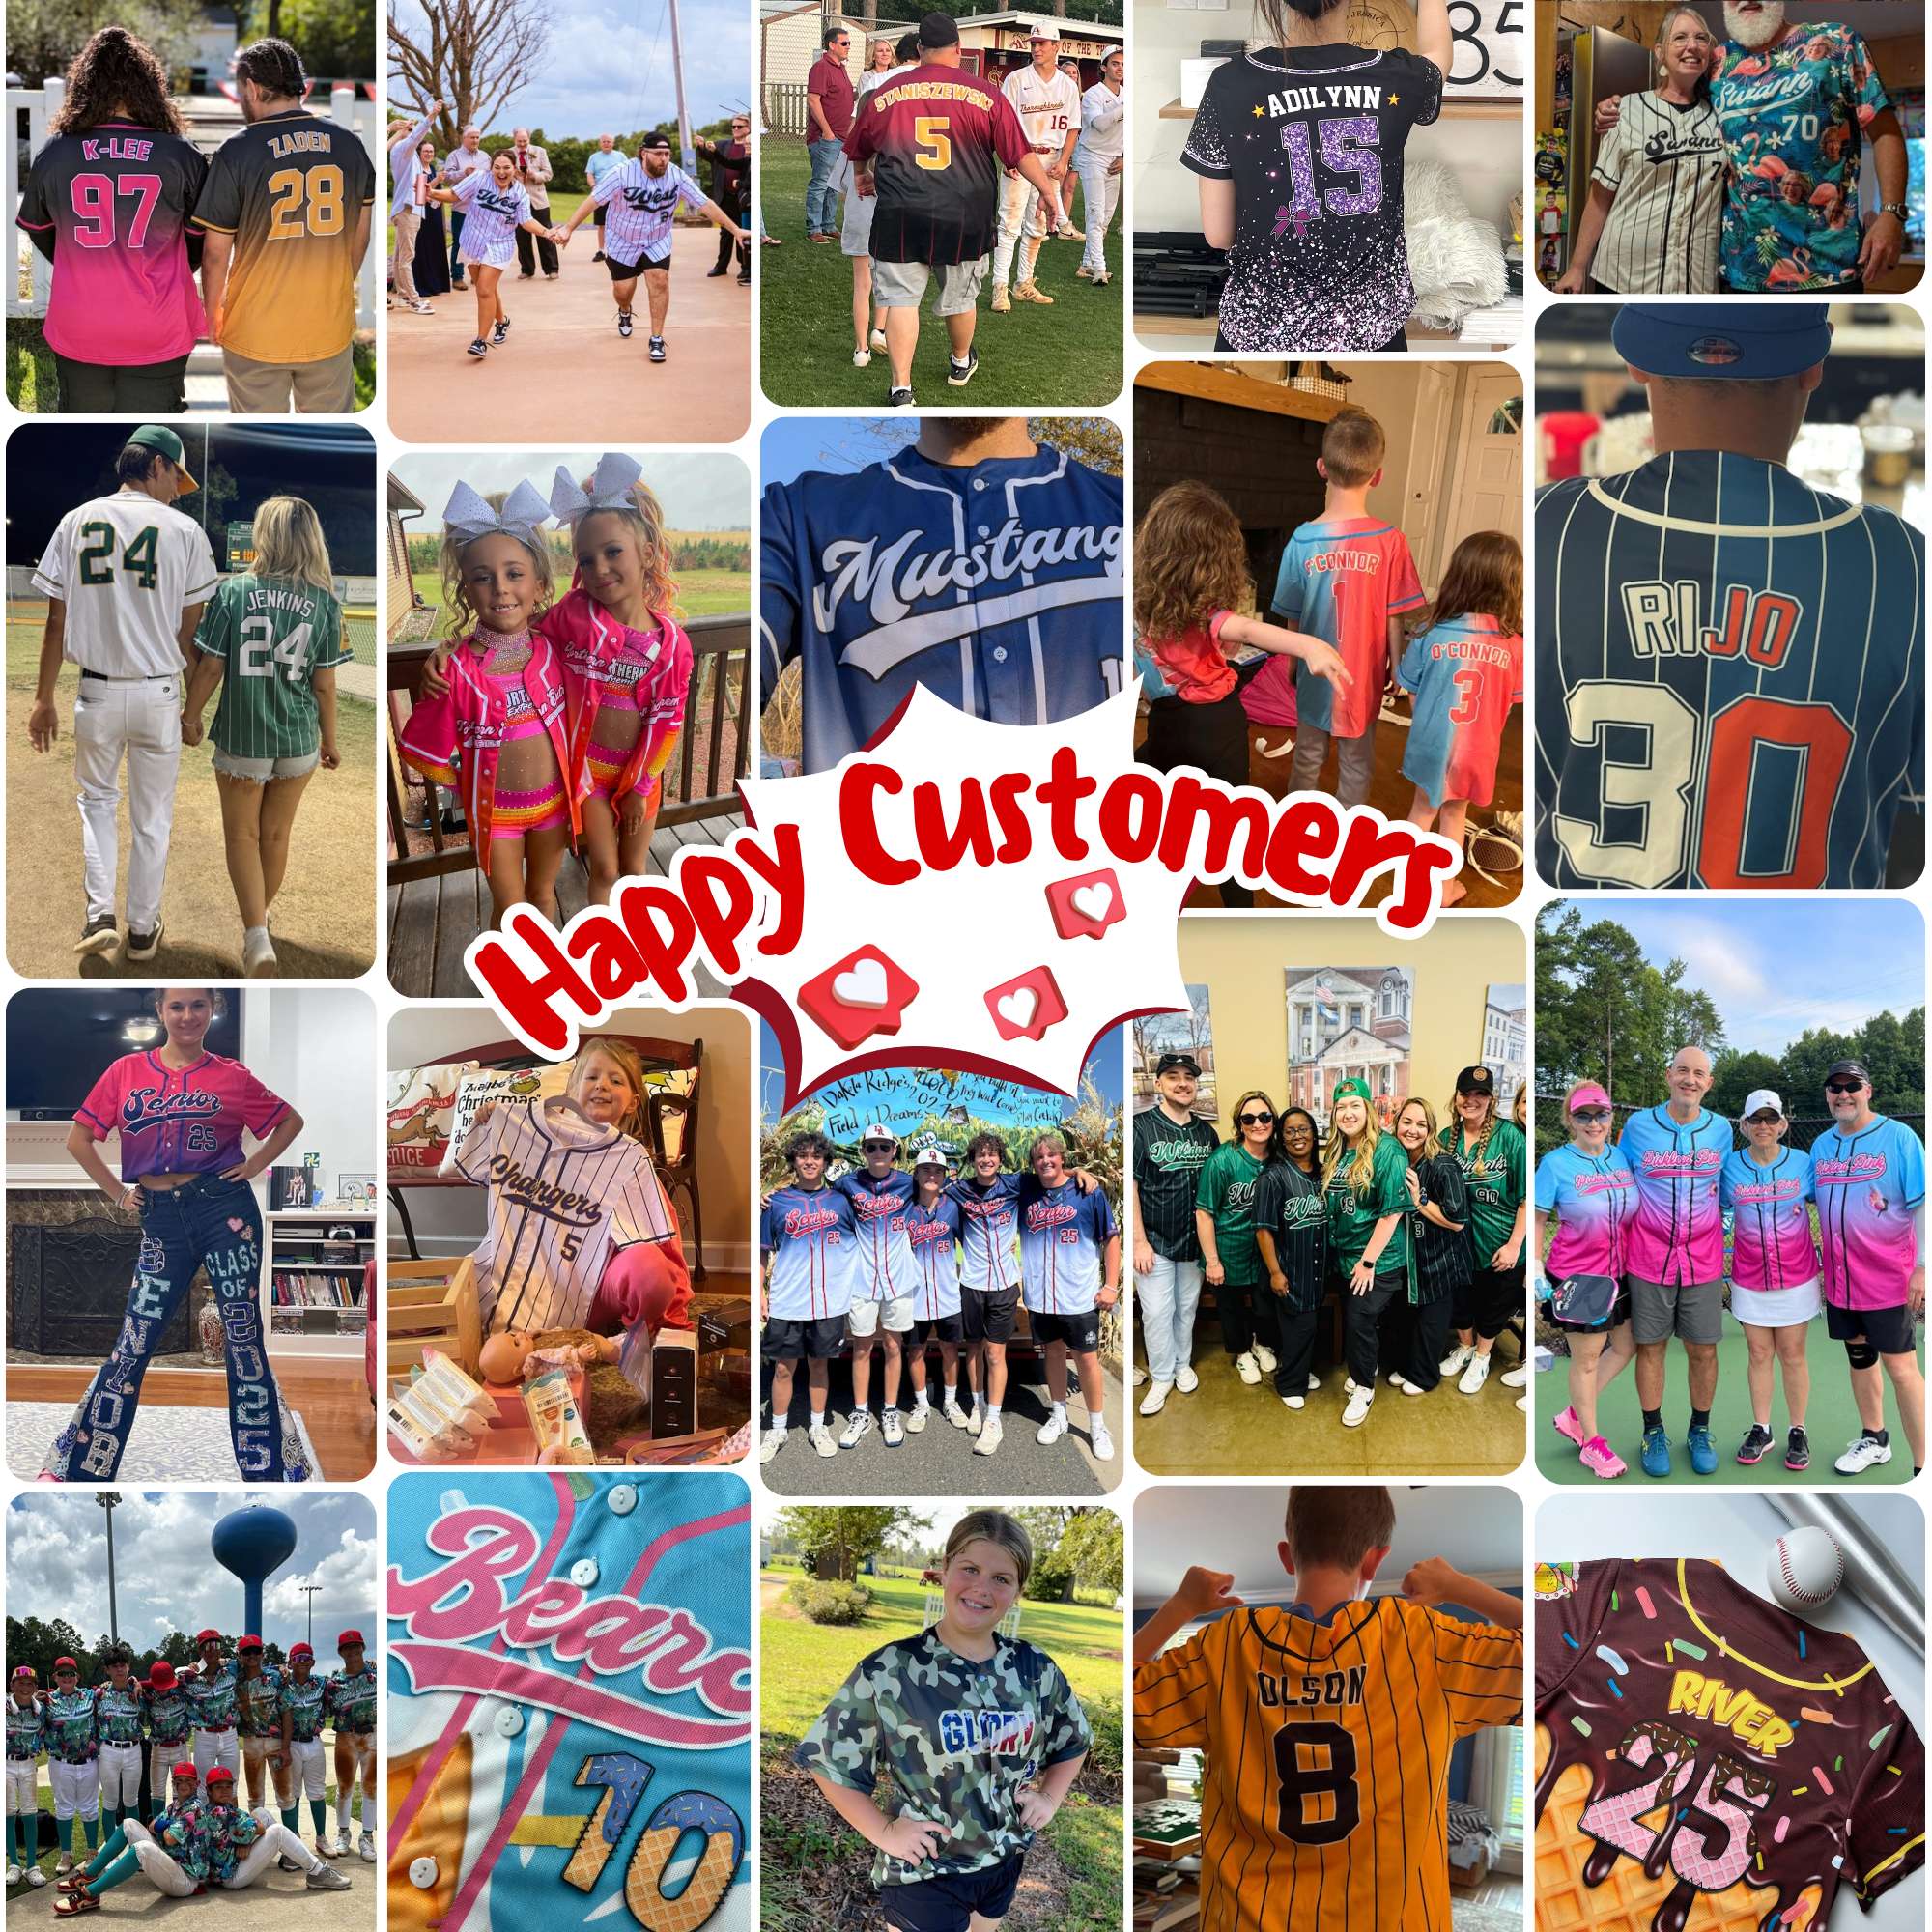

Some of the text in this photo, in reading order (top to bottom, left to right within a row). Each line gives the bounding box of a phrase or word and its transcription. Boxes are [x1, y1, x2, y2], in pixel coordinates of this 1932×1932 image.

[1062, 42, 1072, 54] OF
[1076, 43, 1092, 56] THE
[1267, 86, 1381, 119] ADILYNN
[1714, 71, 1813, 113] Swann
[1051, 115, 1069, 130] 16
[1782, 114, 1819, 142] 70
[82, 138, 154, 161] K-LEE
[268, 131, 331, 159] ZADEN
[915, 117, 951, 170] 5
[1645, 130, 1723, 156] Swann
[1280, 116, 1383, 220] 15
[70, 173, 163, 248] 97
[268, 164, 345, 240] 28
[77, 522, 160, 590] 24
[246, 588, 315, 618] JENKINS
[1621, 580, 1804, 671] RIJO
[239, 615, 315, 681] 24
[1430, 640, 1510, 669] O'CONNOR
[1449, 668, 1484, 725] 3
[1553, 678, 1857, 888] 30
[122, 1088, 223, 1122] Senior
[828, 1106, 860, 1138] Field
[187, 1124, 217, 1151] 25
[1850, 1153, 1887, 1171] Pink
[490, 1154, 602, 1219] Chargers
[1475, 1188, 1499, 1206] 90
[853, 1192, 905, 1215] Senior
[998, 1211, 1012, 1225] 25
[1026, 1202, 1078, 1227] Senior
[785, 1208, 838, 1234] Senior
[891, 1217, 905, 1232] 25
[908, 1219, 951, 1239] Senior
[560, 1233, 583, 1262] 5
[827, 1232, 841, 1245] 25
[937, 1241, 951, 1254] 25
[1059, 1229, 1079, 1245] 25
[205, 1241, 258, 1278] CLASS
[222, 1279, 247, 1299] OF
[222, 1301, 272, 1473] 2025
[1258, 1665, 1367, 1708] OLSON
[1668, 1670, 1795, 1759] RIVER
[938, 1709, 1037, 1756] GLORY
[1273, 1720, 1361, 1846] 8
[1577, 1719, 1779, 1894] 25
